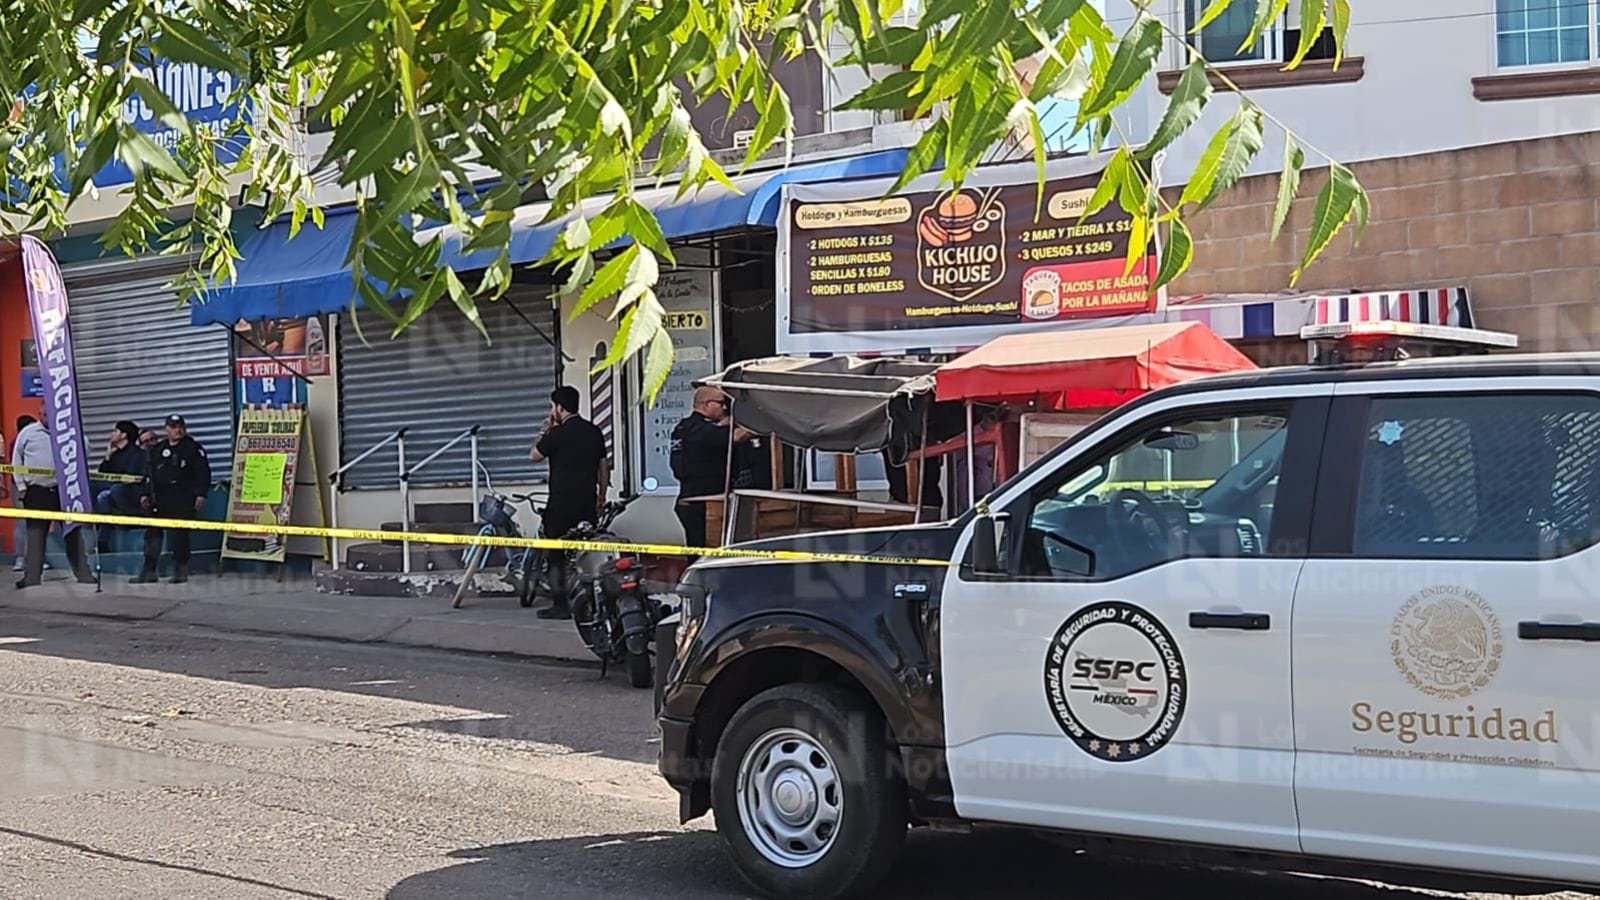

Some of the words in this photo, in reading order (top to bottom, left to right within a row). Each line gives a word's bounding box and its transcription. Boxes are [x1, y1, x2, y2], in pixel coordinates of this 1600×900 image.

[801, 209, 836, 221] Hotdogs
[843, 205, 908, 218] Hamburguesas
[1061, 197, 1089, 210] Sushi
[810, 239, 817, 250] 2
[818, 236, 859, 250] HOTDOGS
[860, 235, 867, 247] X
[868, 234, 893, 246] $135
[1022, 231, 1031, 243] 2
[1032, 229, 1056, 241] MAR
[1058, 228, 1065, 238] Y
[1066, 224, 1104, 238] TIERRA
[1106, 222, 1115, 233] X
[810, 256, 817, 267] 2
[818, 251, 893, 267] HAMBURGUESAS
[924, 244, 998, 268] KICHIJO
[1022, 248, 1030, 260] 3
[1031, 244, 1074, 261] QUESOS
[1075, 243, 1083, 255] X
[1084, 240, 1114, 254] $249
[810, 268, 858, 281] SENCILLAS
[858, 267, 866, 278] X
[866, 265, 892, 278] $180
[932, 264, 992, 286] HOUSE
[811, 284, 842, 296] ORDEN
[843, 283, 857, 294] DE
[857, 280, 905, 293] BONELESS
[1061, 280, 1095, 294] TACOS
[1096, 278, 1111, 290] DE
[1113, 274, 1150, 289] ASADA
[1062, 296, 1084, 309] POR
[1085, 295, 1100, 307] LA
[1101, 289, 1149, 306] MAÑANA
[241, 361, 253, 377] DE
[253, 360, 280, 376] VENTA
[1120, 608, 1131, 621] Y
[1391, 593, 1420, 637] ESTADOS
[1420, 584, 1462, 599] UNIDOS
[1463, 588, 1503, 641] MEXICANOS
[1061, 607, 1116, 645] SEGURIDAD
[1053, 645, 1066, 665] DE
[1130, 612, 1182, 680] PROTECCIÓN
[1071, 657, 1157, 682] SSPC
[1047, 669, 1084, 737] SECRETARÍA
[1145, 682, 1182, 747] CIUDADANA
[1351, 701, 1559, 745] Seguridad
